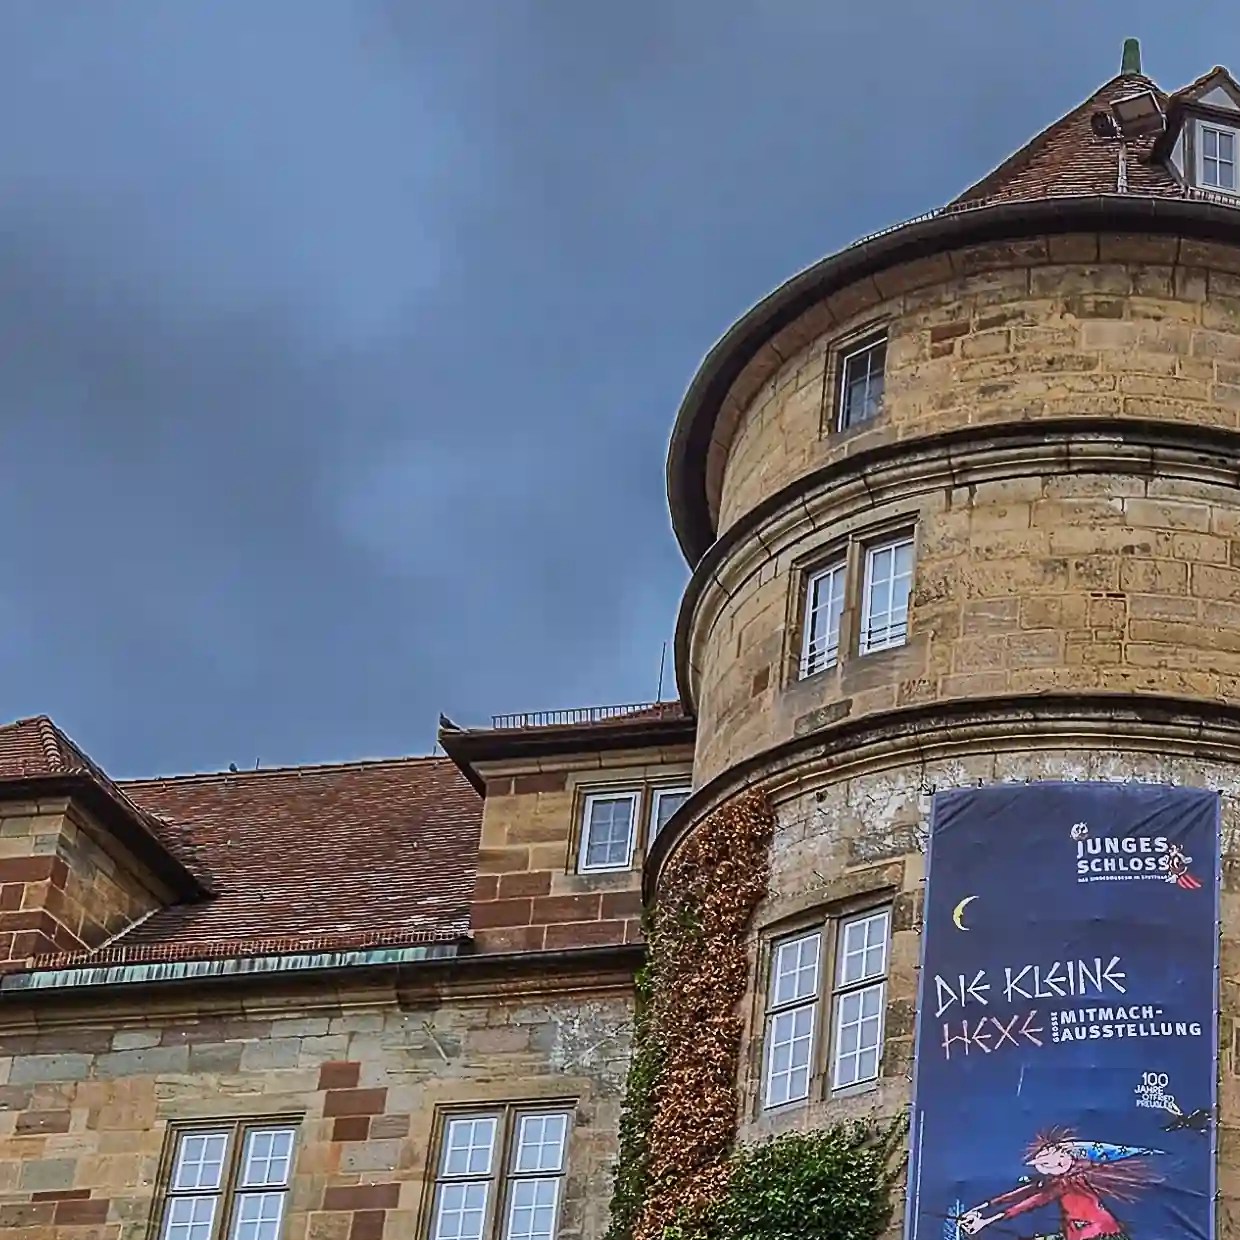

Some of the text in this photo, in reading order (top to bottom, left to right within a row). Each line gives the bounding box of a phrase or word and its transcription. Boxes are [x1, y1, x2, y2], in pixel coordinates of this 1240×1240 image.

[1077, 837, 1168, 859] JUNGES
[1077, 857, 1170, 874] SCHLOSS
[935, 956, 1126, 1018] DIE KLEINE
[1061, 1005, 1163, 1025] MITMACH-
[942, 1010, 1043, 1060] HEXE
[1061, 1022, 1201, 1042] AUSSTELLUNG
[1142, 1072, 1169, 1087] 100
[1134, 1085, 1164, 1096] JAHRE
